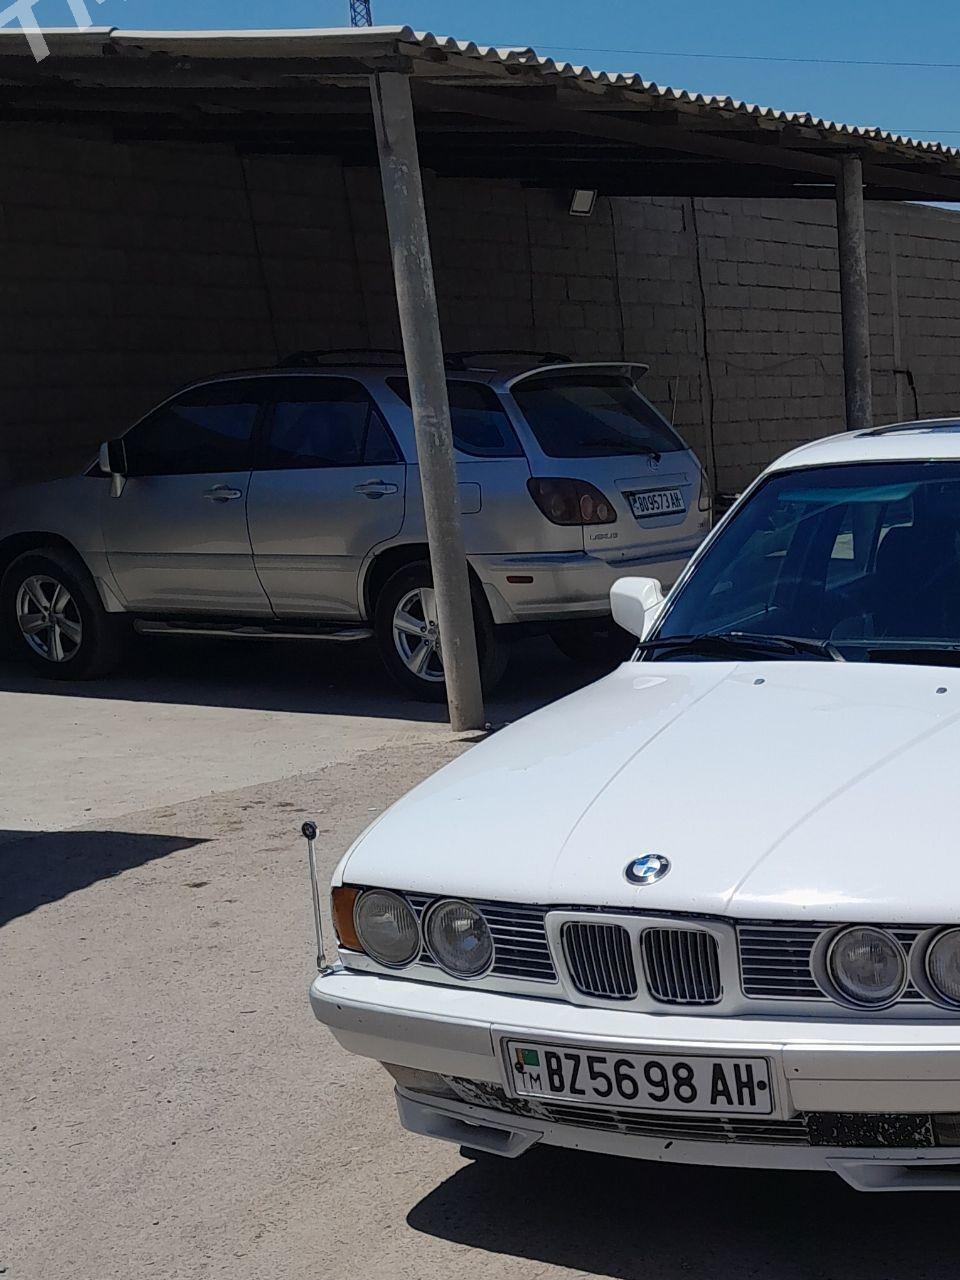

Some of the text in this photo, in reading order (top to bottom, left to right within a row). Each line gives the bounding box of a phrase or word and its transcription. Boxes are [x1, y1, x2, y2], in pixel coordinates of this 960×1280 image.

[519, 1070, 543, 1091] TM
[544, 1050, 757, 1106] BZ5698 AH
